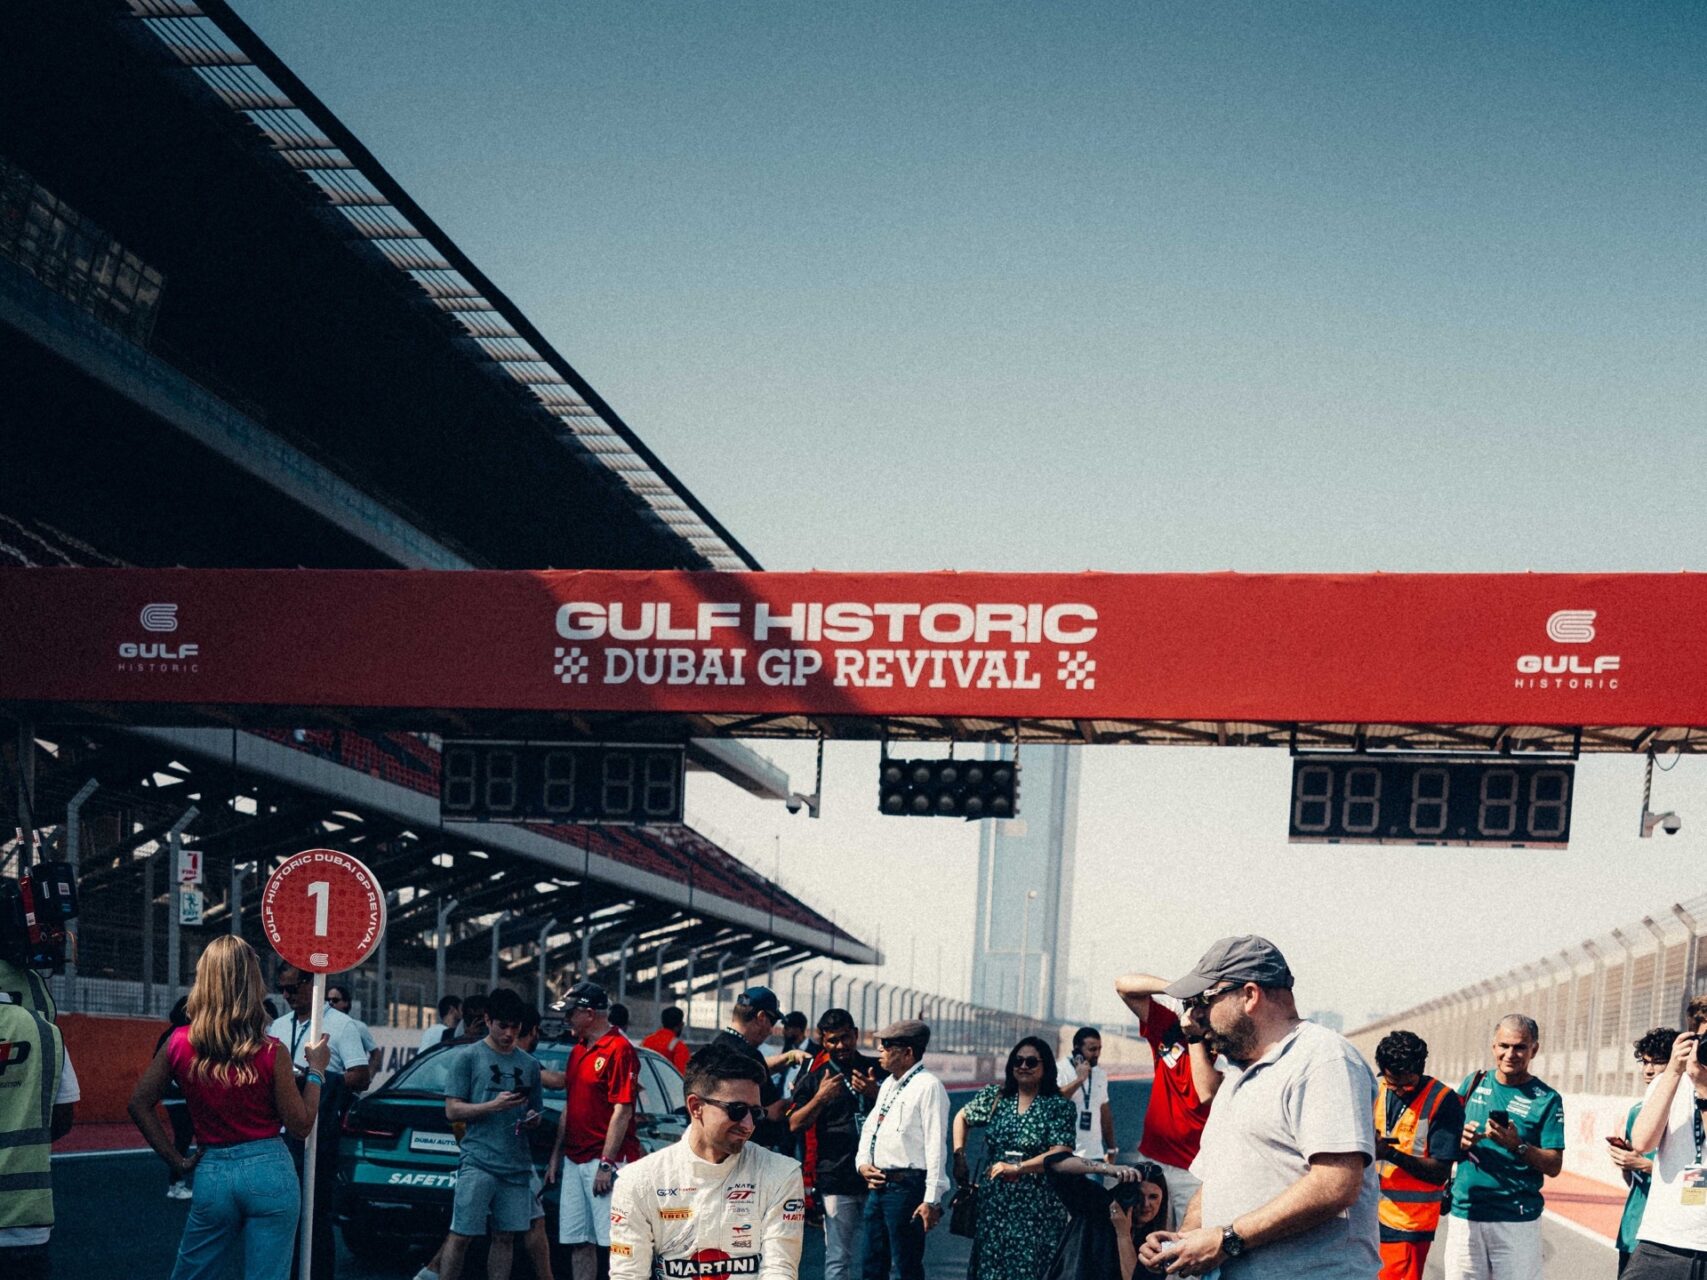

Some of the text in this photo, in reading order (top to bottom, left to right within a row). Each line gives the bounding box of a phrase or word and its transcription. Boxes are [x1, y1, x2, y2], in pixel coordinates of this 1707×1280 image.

[555, 602, 1097, 643] GULF HISTORIC
[119, 643, 198, 658] GULF
[118, 663, 198, 673] HISTORIC
[603, 647, 1041, 690] DUBAI GP REVIVAL
[1516, 655, 1621, 674] GULF
[1514, 678, 1618, 689] HISTORIC
[265, 853, 378, 950] GULF HISTORIC DUBAI GP REVIVAL
[307, 880, 330, 937] 1
[669, 1257, 755, 1276] MARTINI
